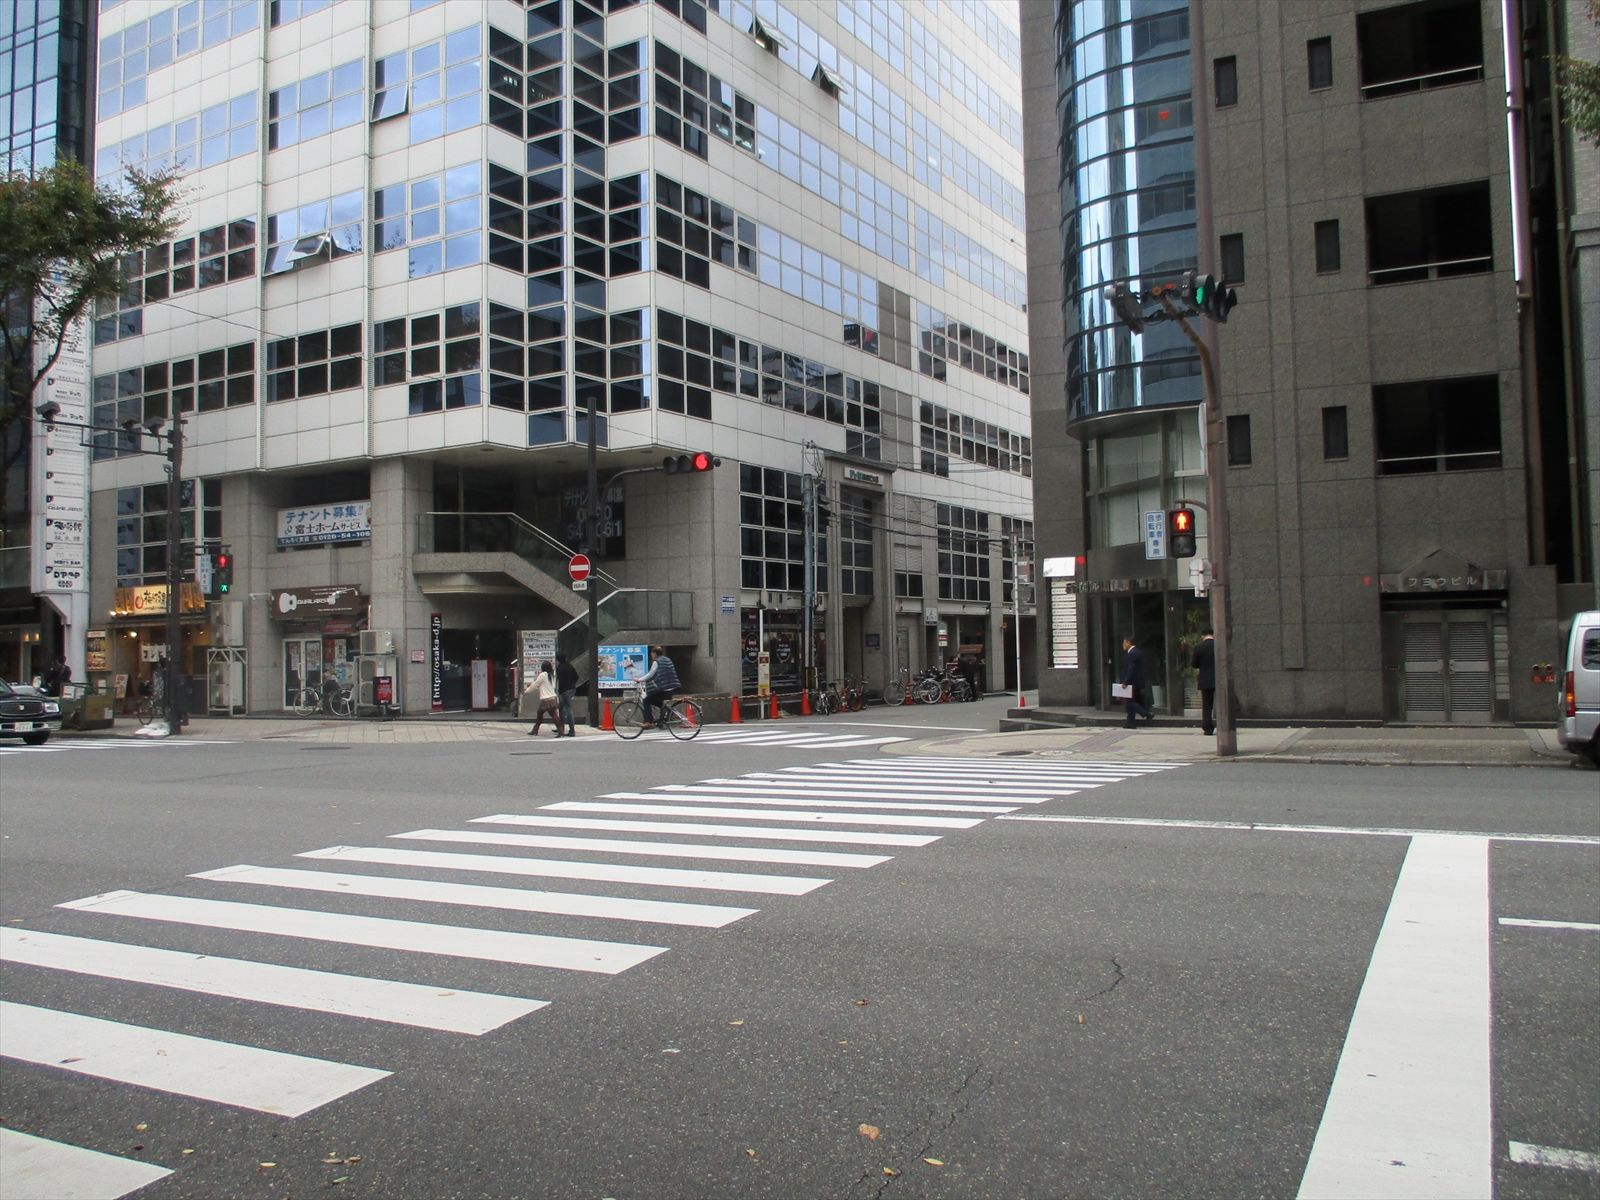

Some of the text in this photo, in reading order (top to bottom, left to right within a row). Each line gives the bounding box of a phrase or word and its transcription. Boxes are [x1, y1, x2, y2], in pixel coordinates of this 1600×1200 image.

[1407, 576, 1479, 587] フヨウビル
[432, 616, 441, 699] http://osaka-d.jp
